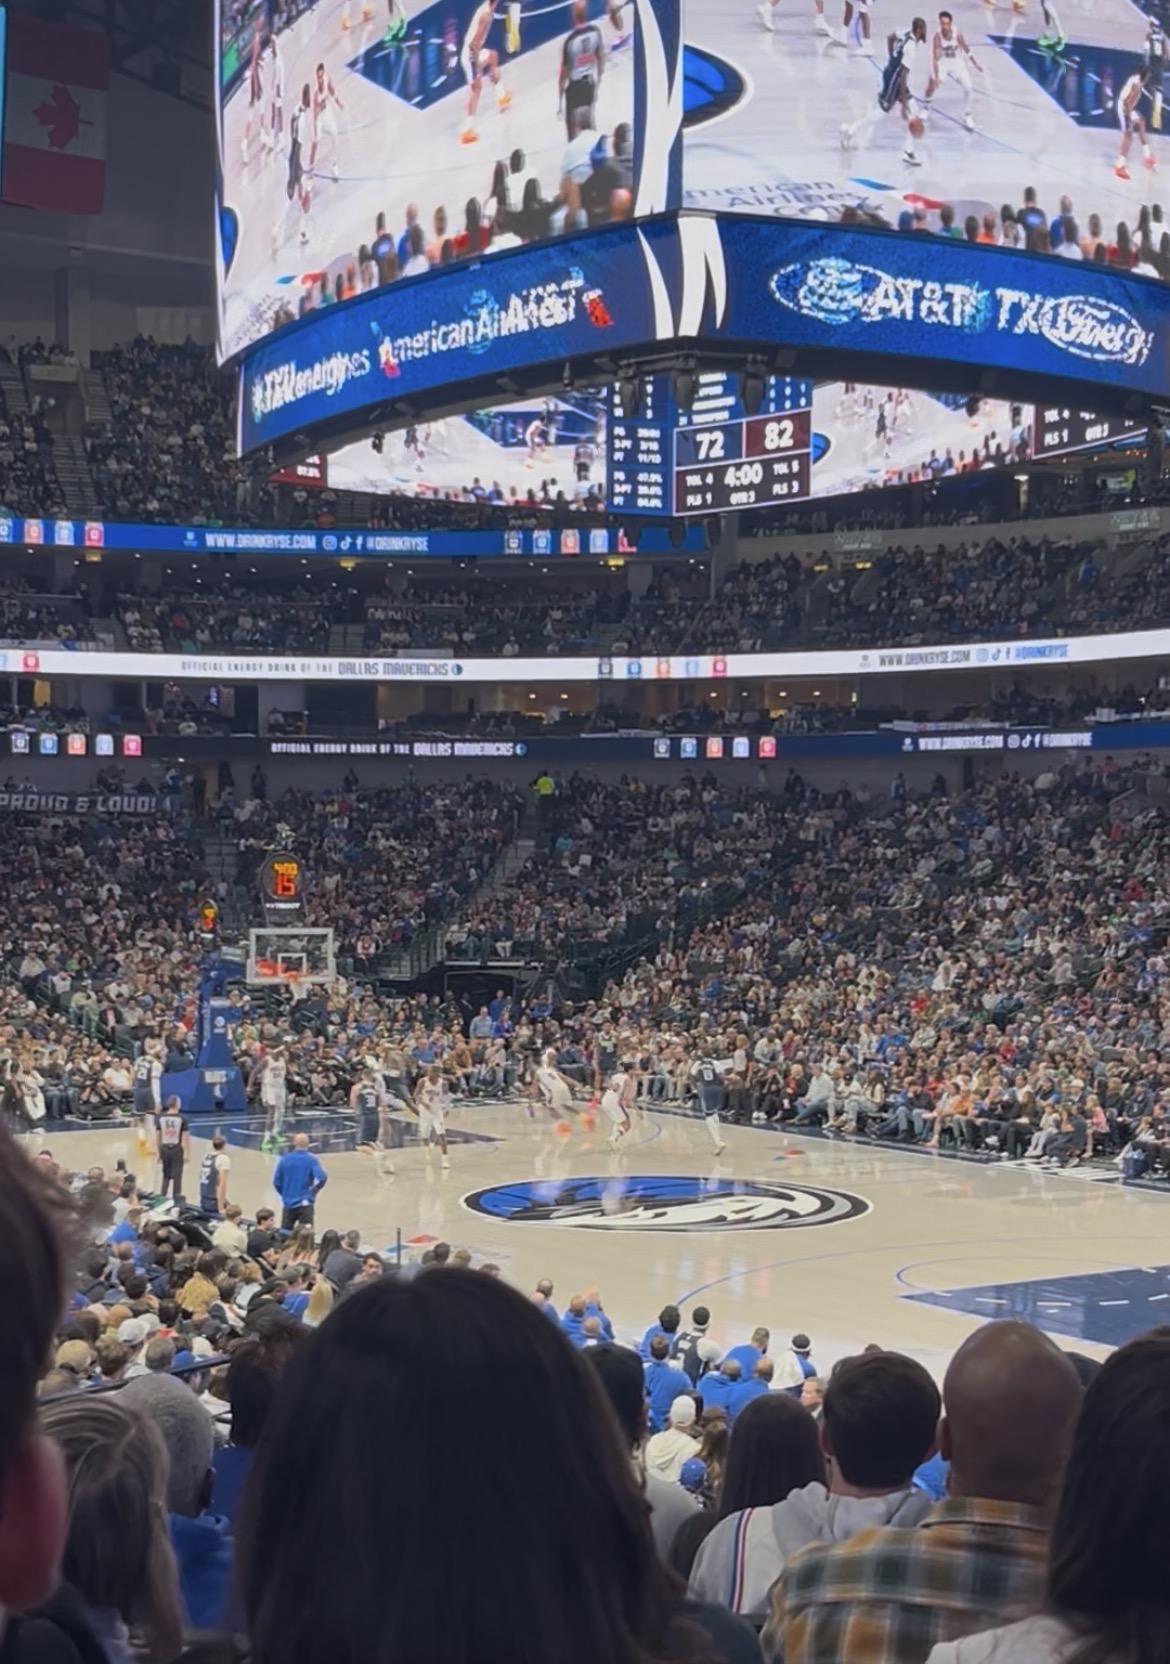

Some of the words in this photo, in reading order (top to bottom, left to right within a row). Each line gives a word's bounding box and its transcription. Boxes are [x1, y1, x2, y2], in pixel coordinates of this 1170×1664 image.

[684, 180, 835, 199] merican
[764, 420, 794, 450] 82
[696, 431, 725, 460] 72
[724, 462, 763, 488] 4:00
[705, 492, 712, 504] 1
[205, 532, 317, 550] WWW.DRINKRYSE.COM
[879, 650, 971, 667] WWW.DRINKRYSE.COM
[338, 661, 379, 675] DALLAS
[383, 662, 449, 676] MAVERICKS
[0, 793, 68, 811] PROUD
[277, 876, 296, 896] 15
